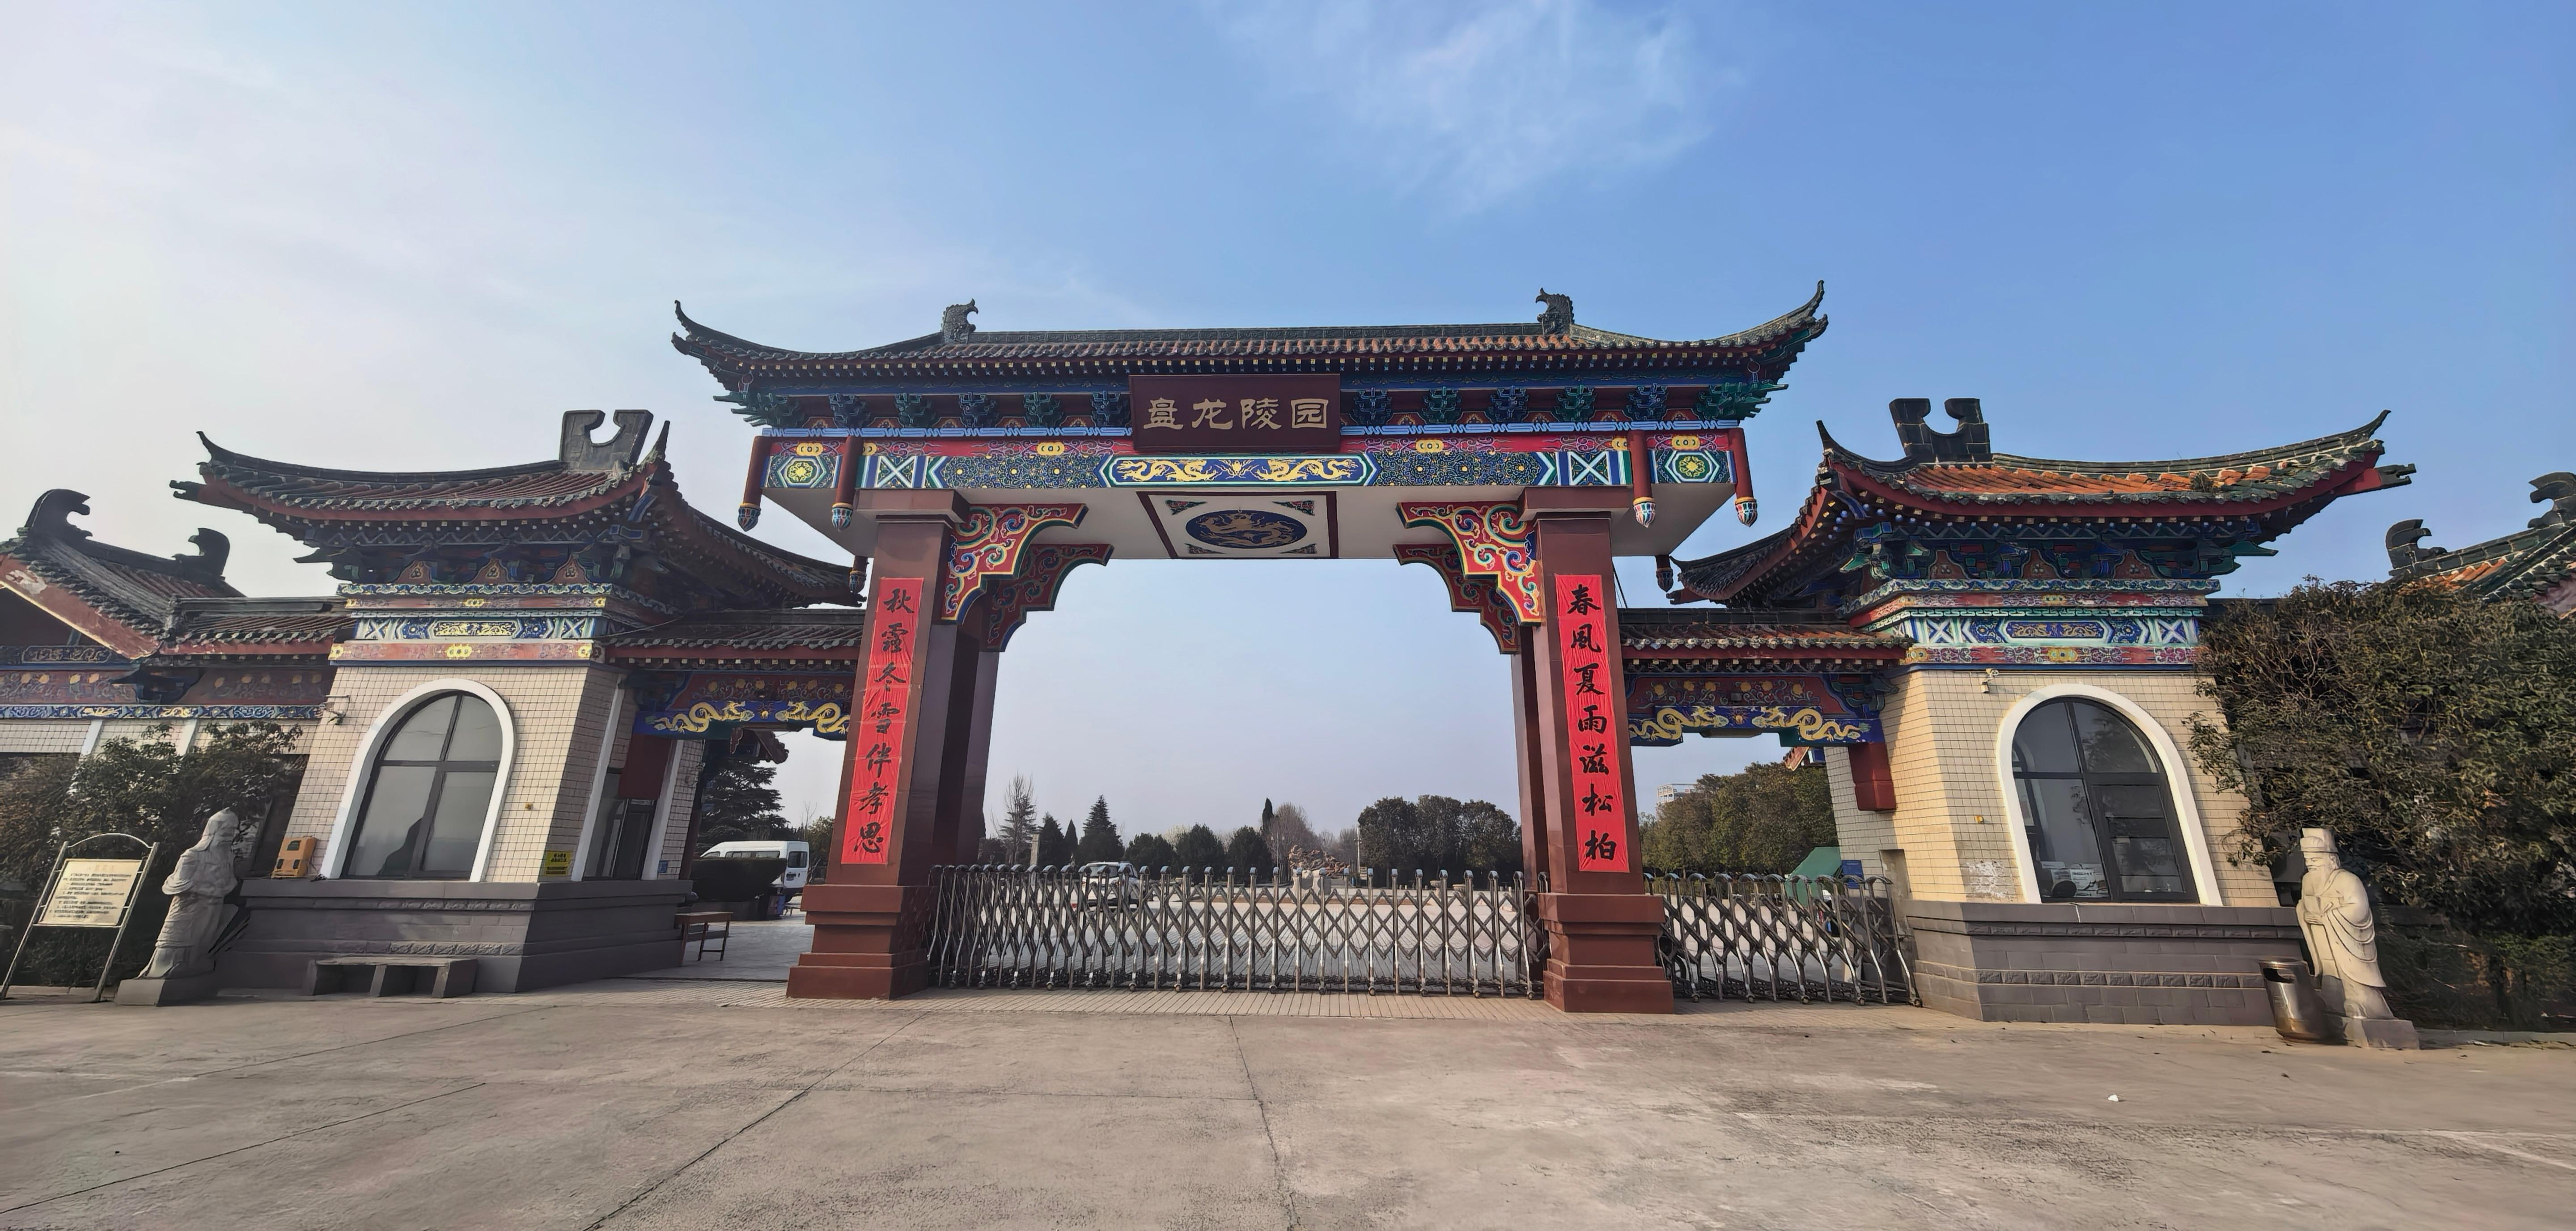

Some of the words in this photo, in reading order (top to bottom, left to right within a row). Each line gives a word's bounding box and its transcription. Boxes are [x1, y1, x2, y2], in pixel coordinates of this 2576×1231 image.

[1143, 397, 1329, 430] 盘龙陵园
[1567, 584, 1617, 861] 春風夏雨滋松柏
